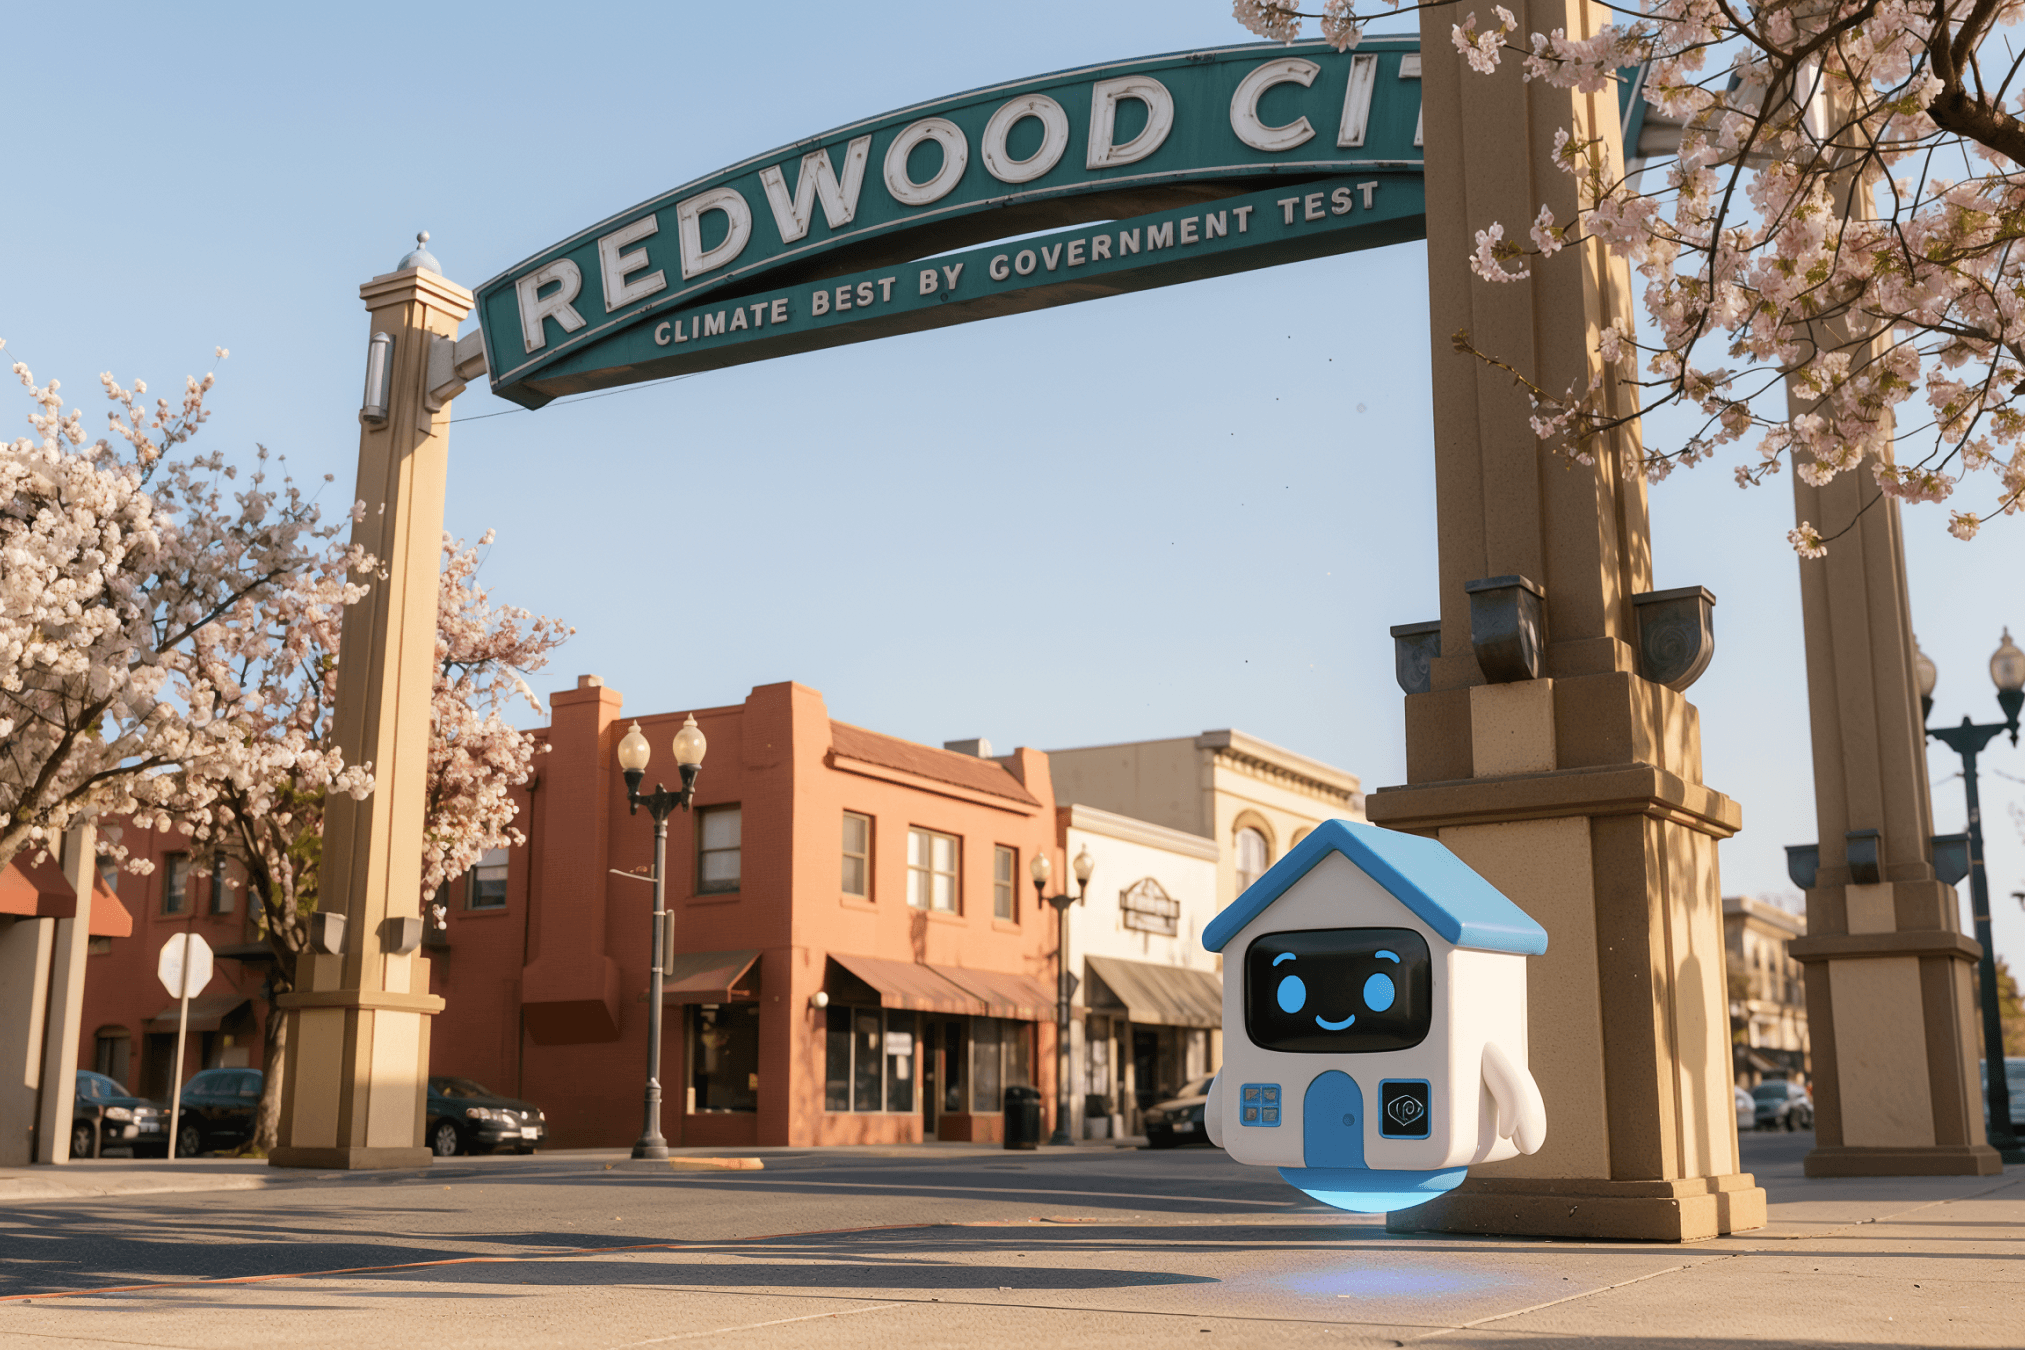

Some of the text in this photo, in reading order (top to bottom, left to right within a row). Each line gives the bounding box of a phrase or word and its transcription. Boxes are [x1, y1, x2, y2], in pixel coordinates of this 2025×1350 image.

[515, 53, 1423, 354] REDWOOD CI
[654, 180, 1379, 346] CLIMATE BEST BY GOVERNMENT TEST
